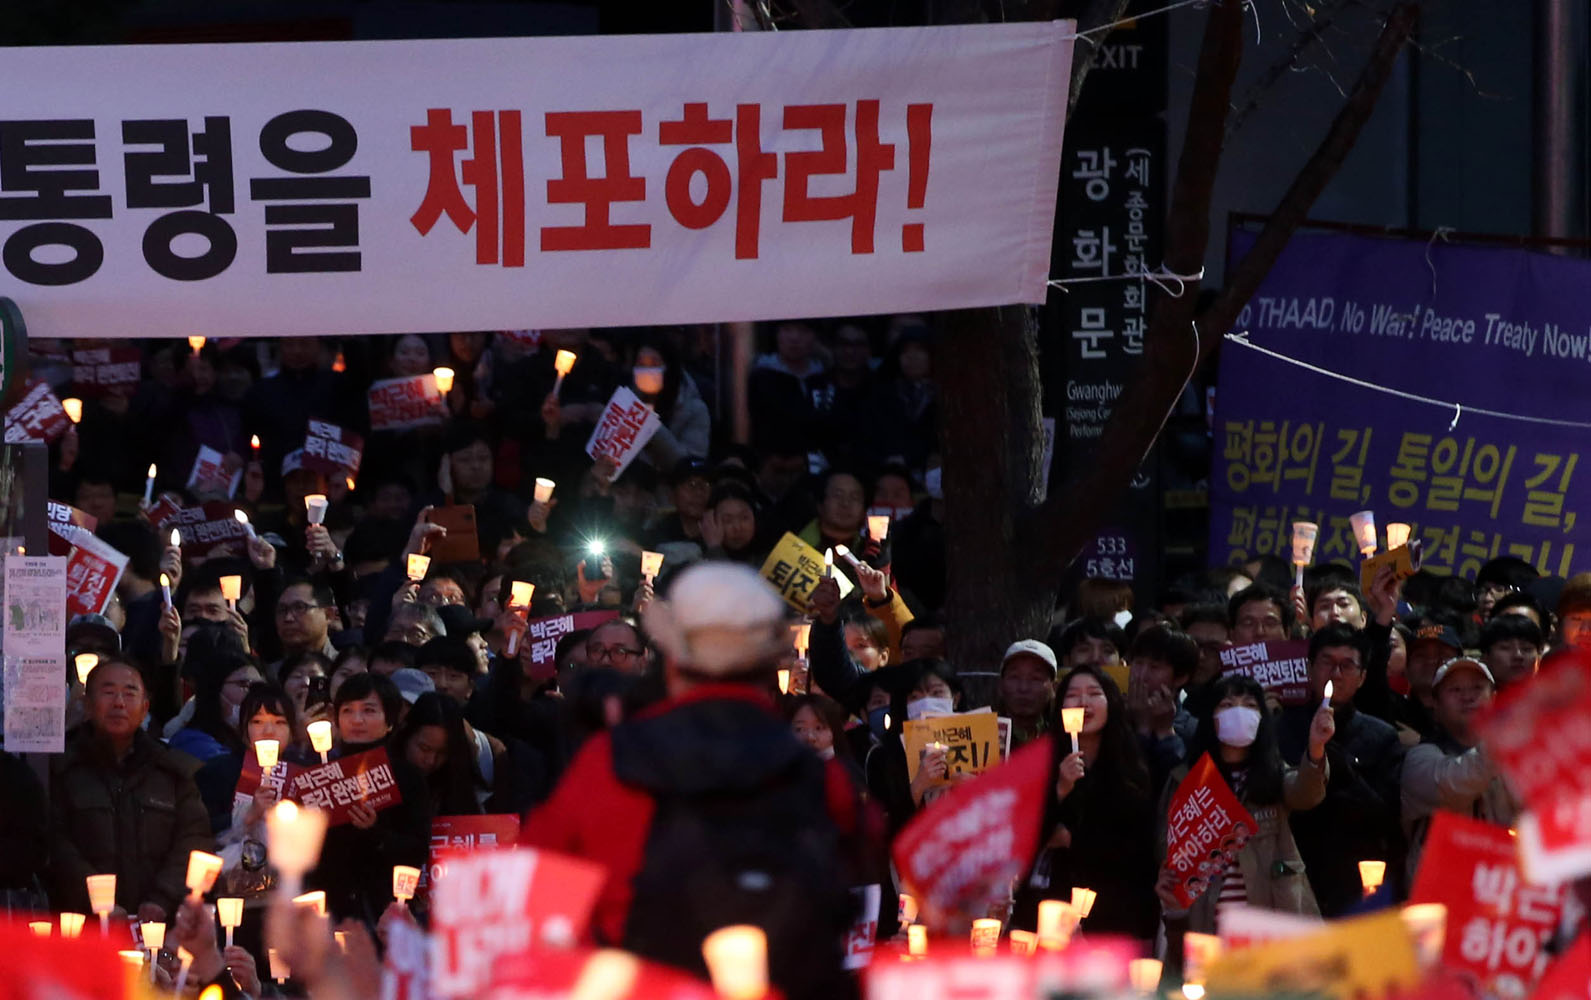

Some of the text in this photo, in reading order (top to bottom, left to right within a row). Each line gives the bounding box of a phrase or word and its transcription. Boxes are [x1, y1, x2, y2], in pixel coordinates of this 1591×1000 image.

[409, 98, 934, 268] 체포하라!
[1071, 146, 1119, 360] 광화문
[1258, 297, 1336, 332] THAAD,
[1340, 302, 1365, 333] No
[1370, 304, 1421, 340] War!
[1420, 312, 1476, 344] Peace
[1483, 313, 1538, 357] Treaty
[1542, 322, 1591, 361] Now!
[1223, 419, 1580, 534] 평화의 길, 통일의 길,
[1096, 536, 1127, 555] 533
[1086, 557, 1134, 581] 5호선
[530, 614, 575, 639] 박근혜
[531, 637, 557, 664] 즉각
[1219, 641, 1269, 667] 박근혜
[933, 726, 973, 742] 박근혜
[294, 761, 345, 790] 박근혜
[330, 763, 396, 806] 완전퇴진!
[1171, 803, 1232, 873] 하야하라
